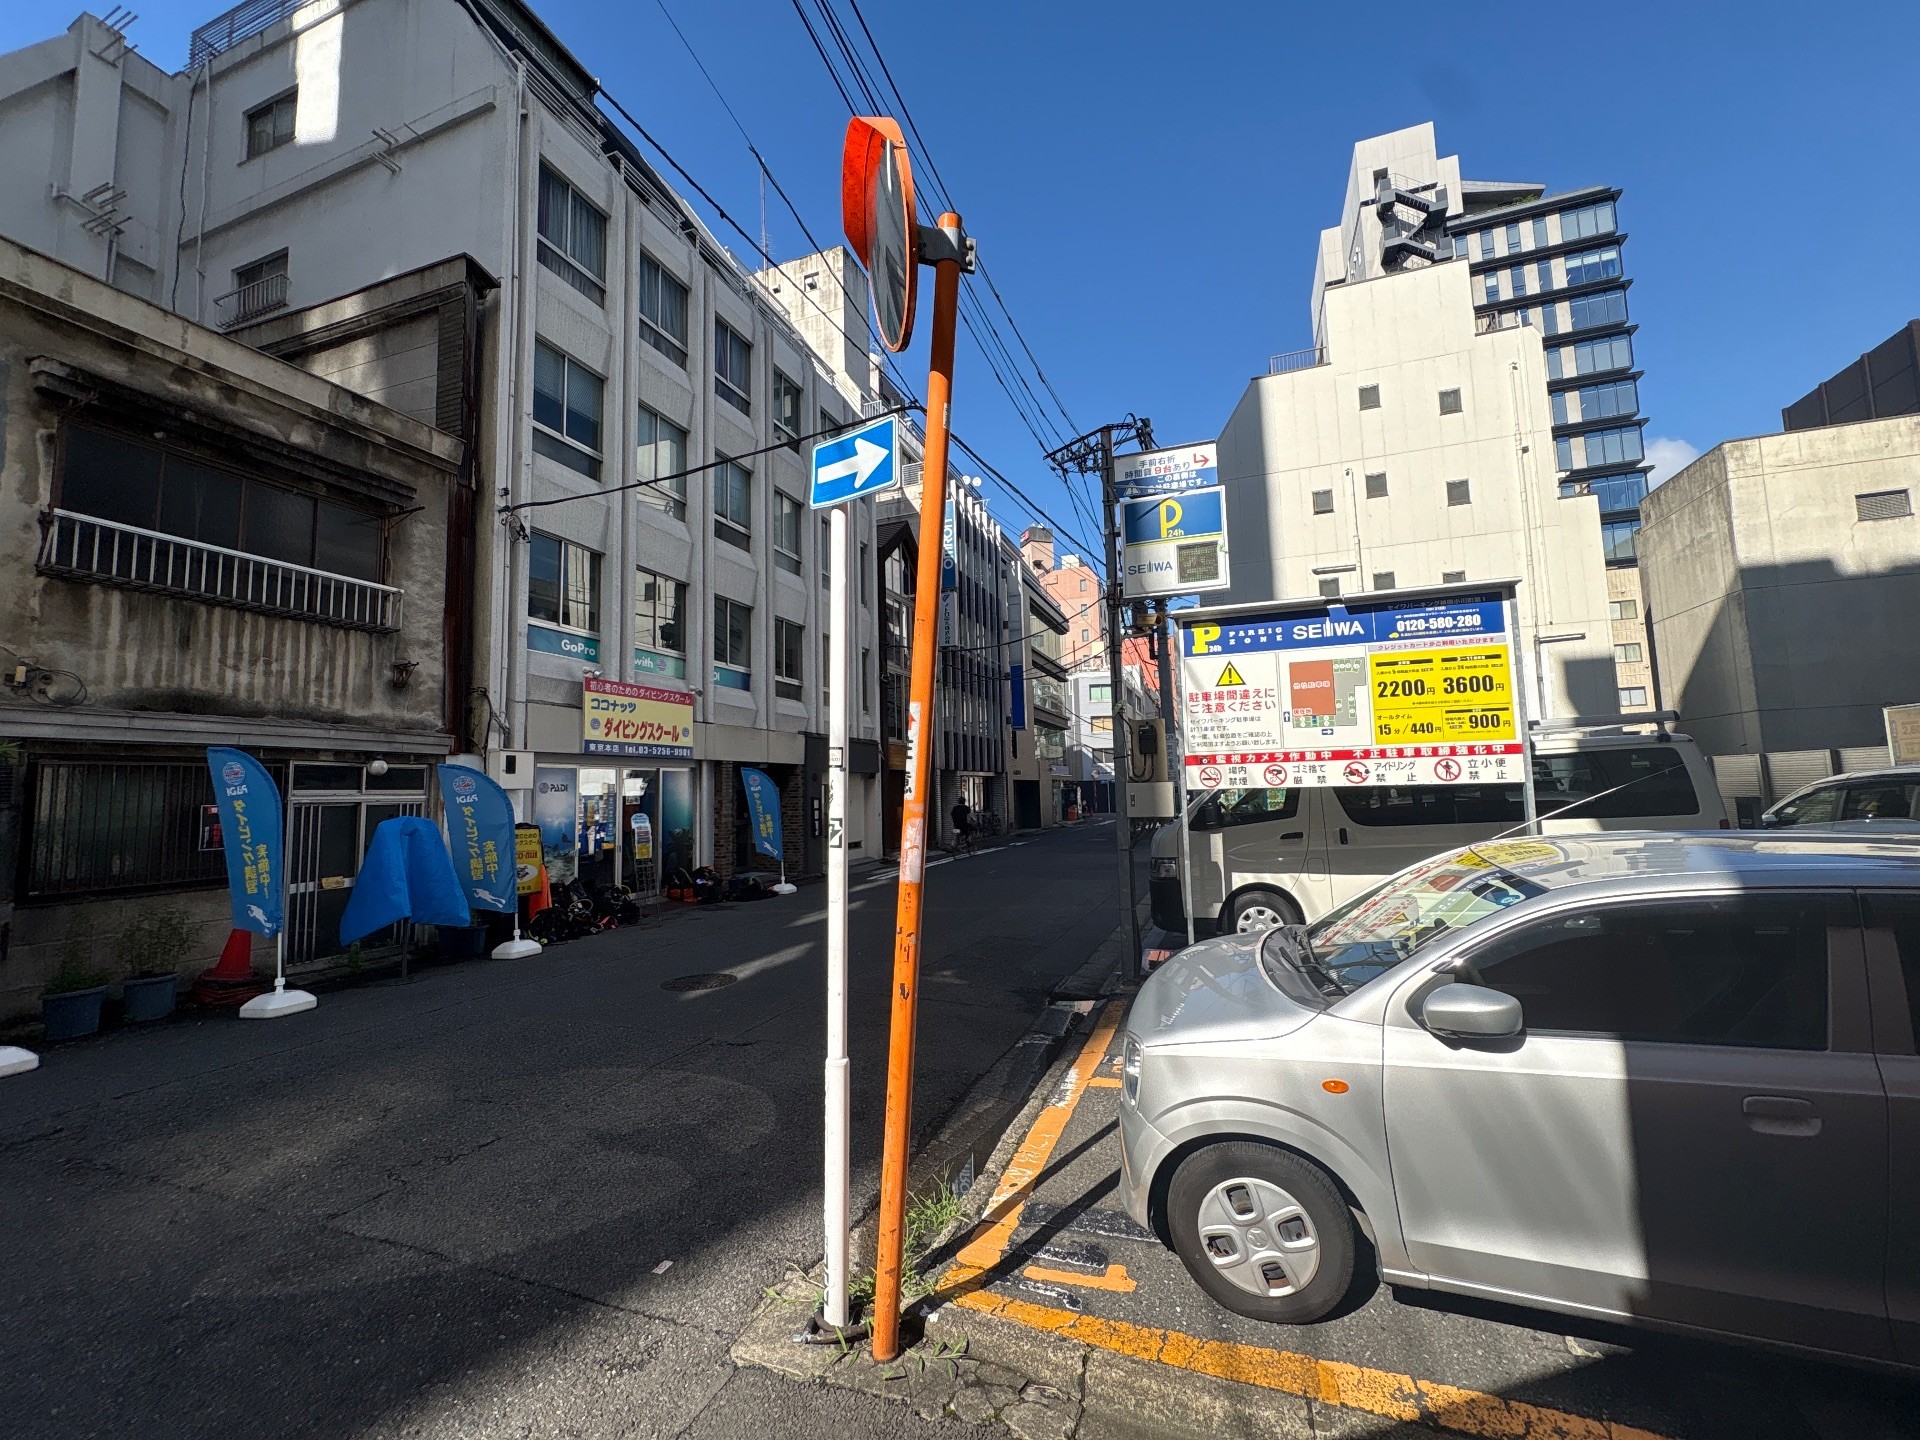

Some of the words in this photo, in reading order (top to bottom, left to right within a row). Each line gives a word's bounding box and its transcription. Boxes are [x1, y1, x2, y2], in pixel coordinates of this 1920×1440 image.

[1139, 455, 1176, 469] 手前右折
[1167, 529, 1185, 538] 24h
[1396, 614, 1481, 632] 0120-580-280
[561, 639, 596, 656] GoPro
[1377, 637, 1495, 651] クレジットカードがご利用いただけます
[634, 656, 654, 669] with
[589, 681, 691, 704] 初心者のためのダイビングスクール
[1188, 688, 1276, 703] 駐車場間違えに
[590, 698, 637, 713] ココナッツ
[1189, 700, 1276, 714] ご注意ください
[1190, 716, 1262, 725] セイワパーキング駐車場は
[604, 718, 680, 743] ダイビングスクール
[589, 743, 620, 752] 東京本店
[1215, 751, 1333, 764] 監視カメラ作動中
[1353, 745, 1506, 759] 不正駐車取締強化中
[1292, 764, 1327, 774] ゴミ捨て
[1374, 761, 1416, 771] アイドリング
[1468, 758, 1507, 769] 立小便
[1228, 766, 1247, 775] 場内
[550, 783, 568, 793] PADI
[1228, 777, 1249, 786] 禁煙
